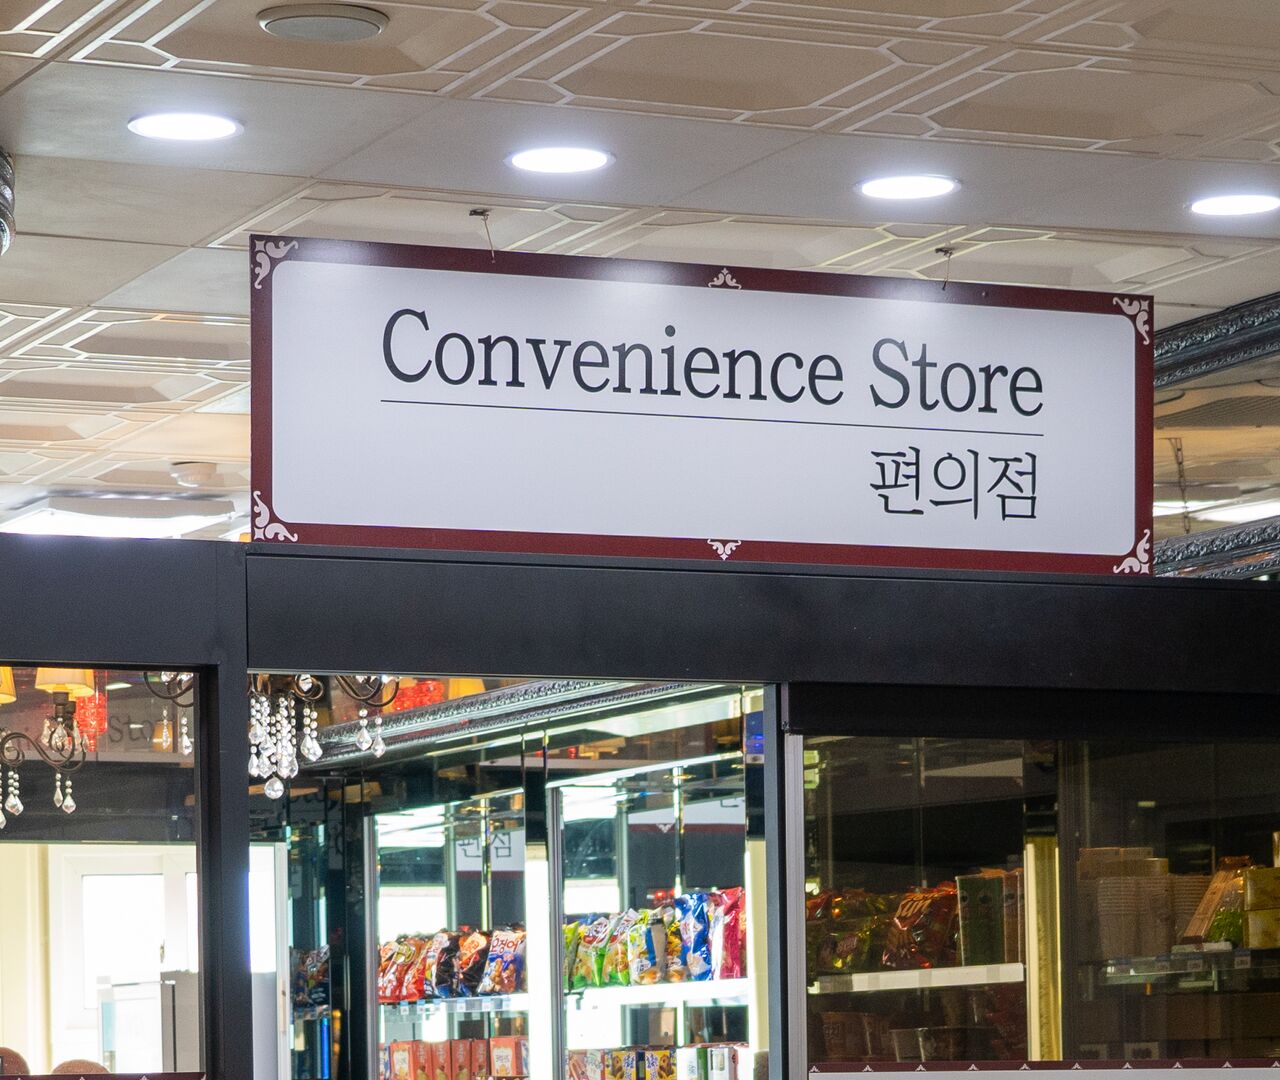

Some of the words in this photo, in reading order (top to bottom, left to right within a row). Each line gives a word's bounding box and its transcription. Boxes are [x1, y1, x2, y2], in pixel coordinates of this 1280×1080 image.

[381, 307, 845, 406] Convenience
[868, 336, 1045, 418] Store
[869, 446, 1037, 521] 편의점
